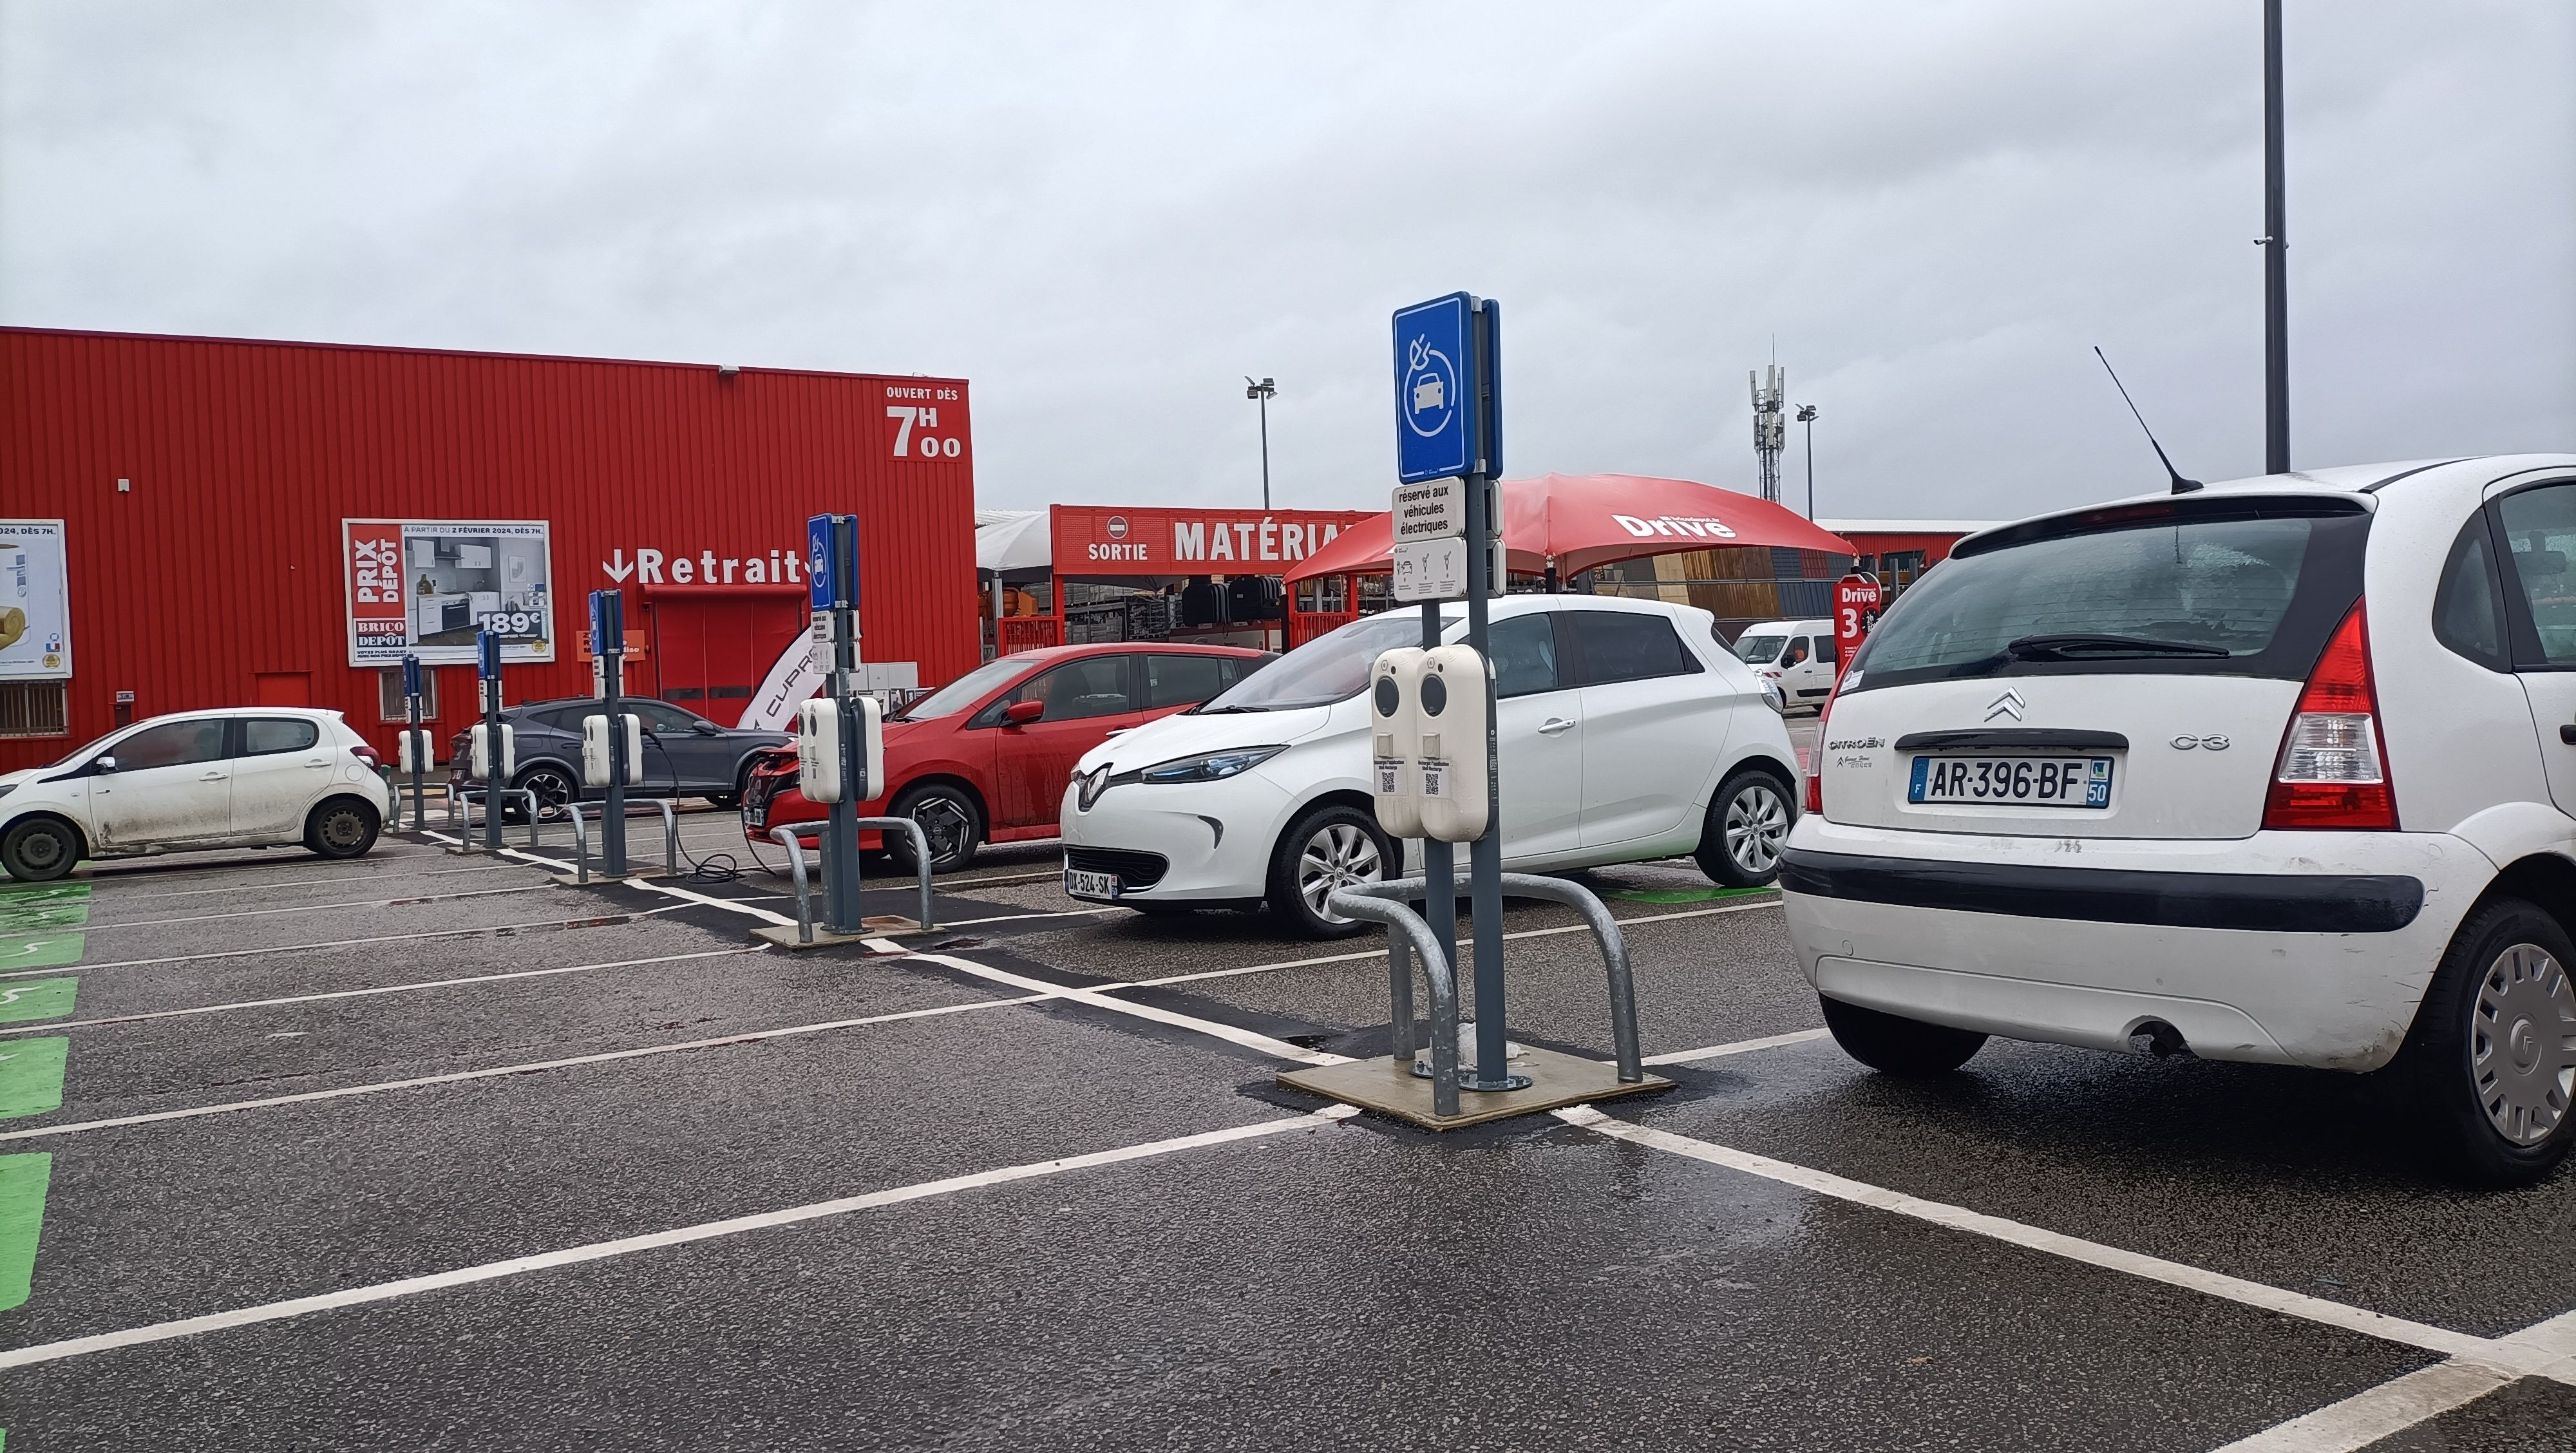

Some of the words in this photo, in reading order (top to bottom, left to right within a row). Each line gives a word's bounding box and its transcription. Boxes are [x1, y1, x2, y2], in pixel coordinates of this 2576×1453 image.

[886, 386, 931, 399] OUVERT
[937, 387, 958, 401] DÈS
[1399, 485, 1430, 502] réservé
[1432, 486, 1448, 498] aux
[1404, 502, 1444, 518] véhicules
[1401, 519, 1448, 535] électriques
[1611, 515, 1737, 538] Drive
[1175, 517, 1355, 561] MATÉRI
[1088, 542, 1148, 561] SORTIE
[355, 539, 379, 603] PRIX
[377, 538, 399, 603] DÉPÔT
[637, 548, 800, 584] Retrait
[1842, 587, 1877, 603] Drive
[357, 622, 404, 632] BRICO
[478, 612, 541, 634] 189€
[1842, 607, 1858, 638] 3
[358, 632, 405, 646] DEPÔT
[2169, 733, 2230, 752] C3
[1915, 784, 1922, 793] F
[1931, 761, 2083, 799] AR-396-BF
[2087, 784, 2107, 802] 50
[1069, 871, 1110, 895] DX-524-SK
